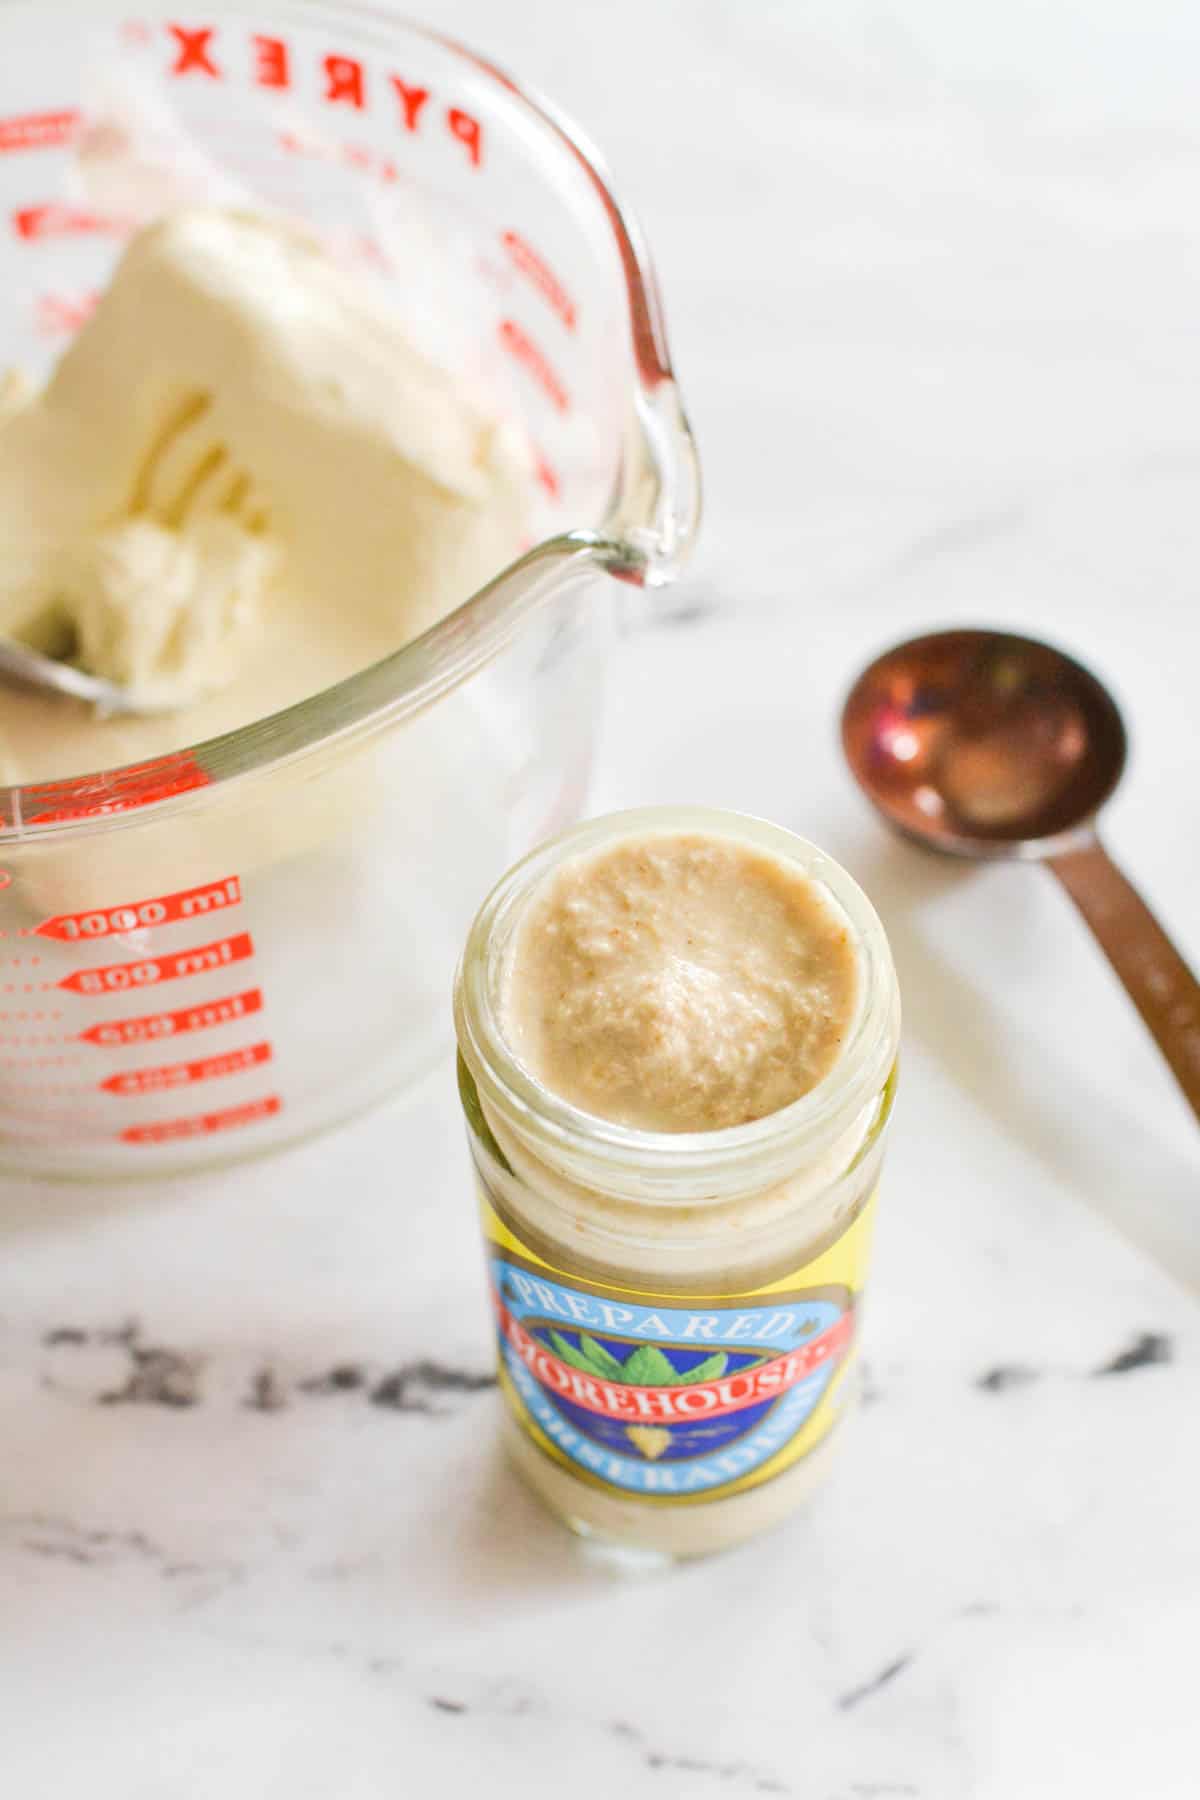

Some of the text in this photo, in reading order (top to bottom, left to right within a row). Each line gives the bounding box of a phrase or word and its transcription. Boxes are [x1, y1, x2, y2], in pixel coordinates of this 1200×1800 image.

[59, 879, 238, 938] 1000 ml
[176, 942, 232, 976] ml
[508, 1272, 796, 1340] PREPARED
[509, 1319, 813, 1418] MOREHOUSE
